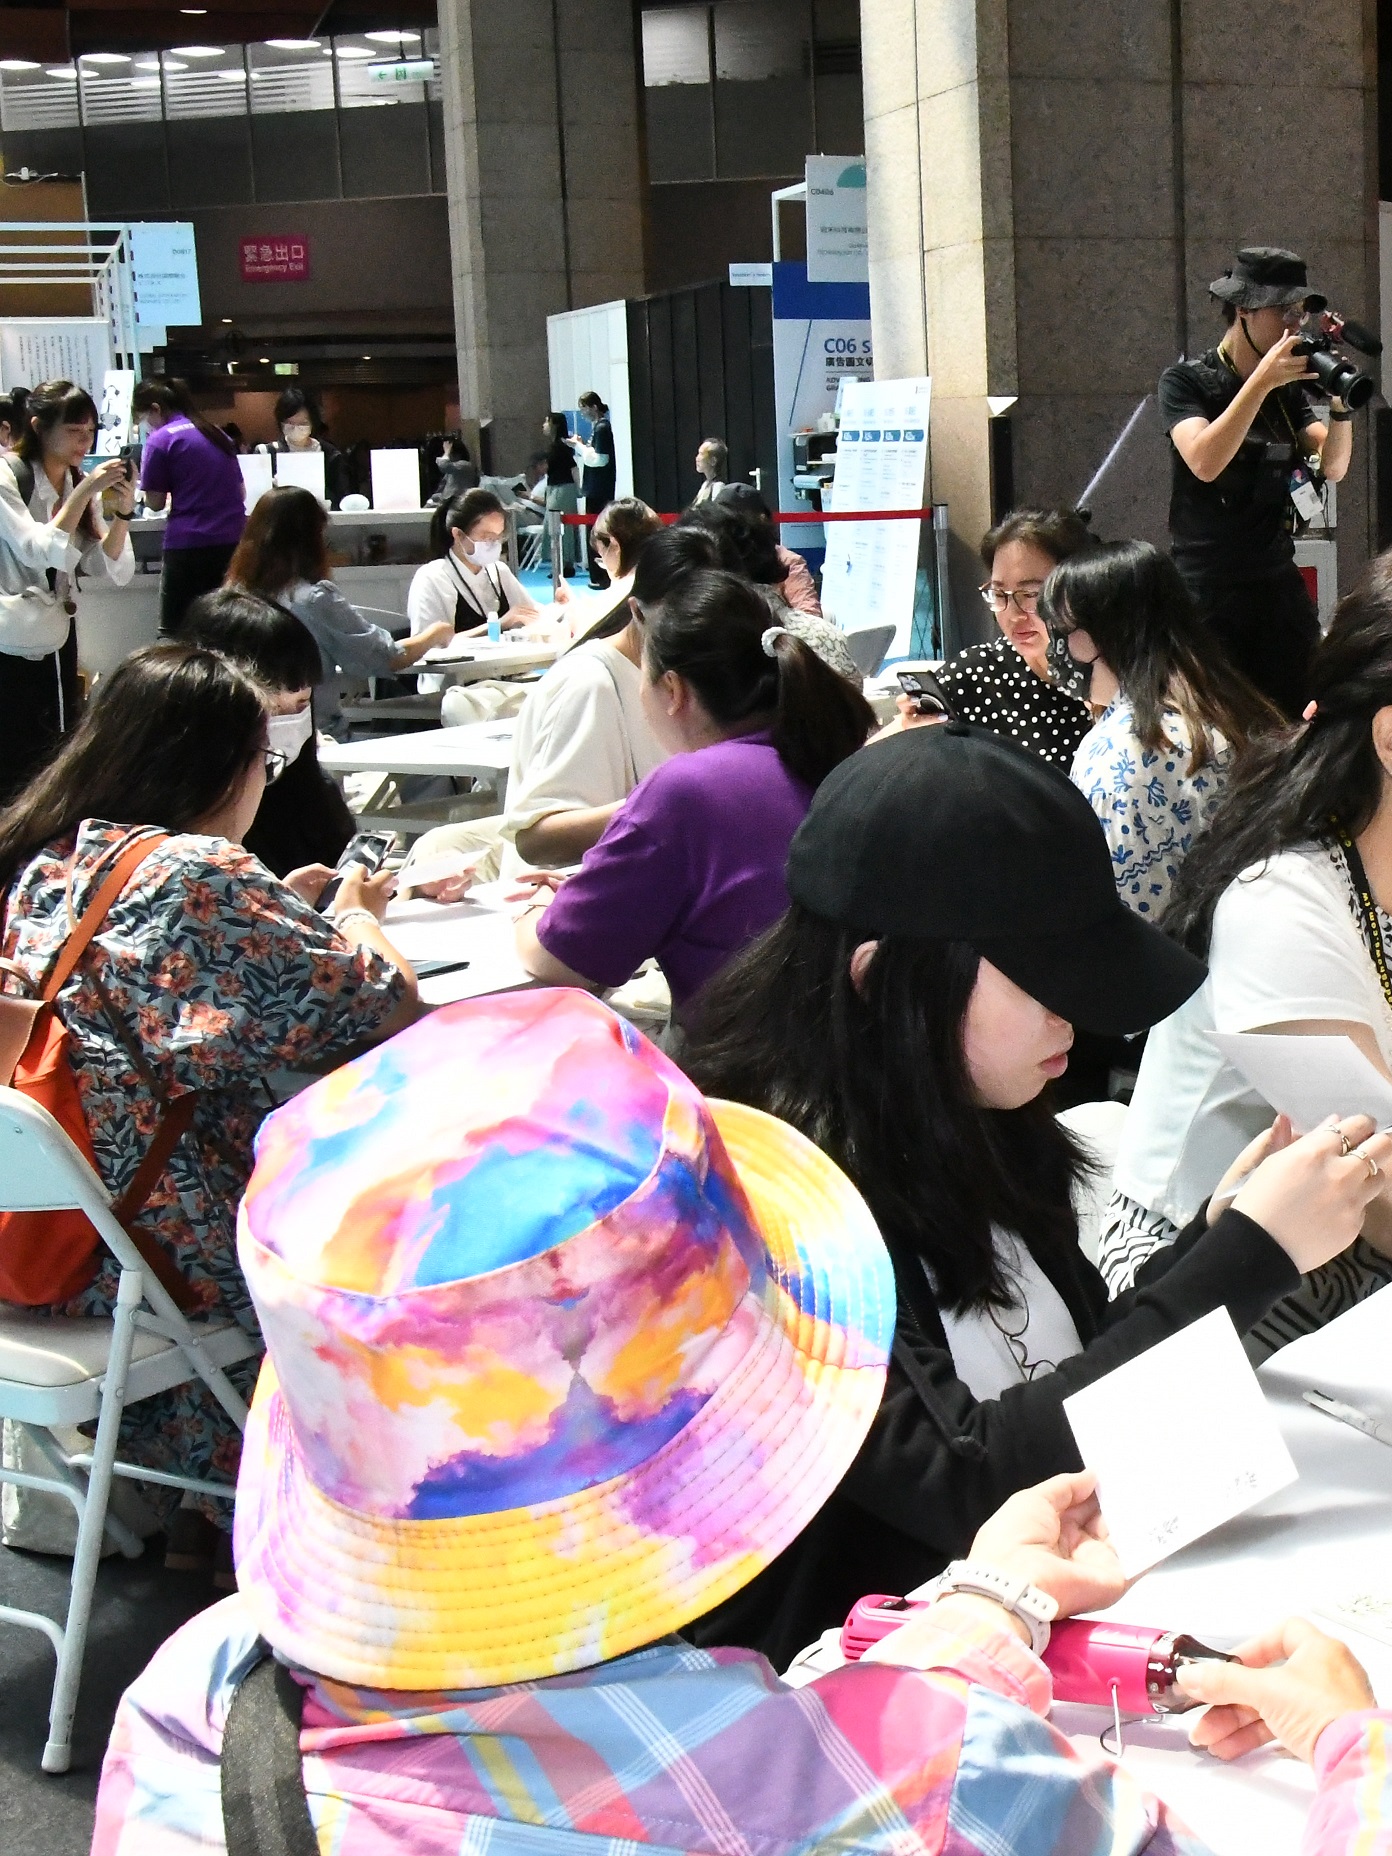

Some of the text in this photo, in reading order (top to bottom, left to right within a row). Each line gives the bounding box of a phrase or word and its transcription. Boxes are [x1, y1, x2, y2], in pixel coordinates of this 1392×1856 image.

[243, 244, 304, 263] 緊急出口
[245, 262, 304, 274] Emergency Exit
[824, 338, 857, 353] C06
